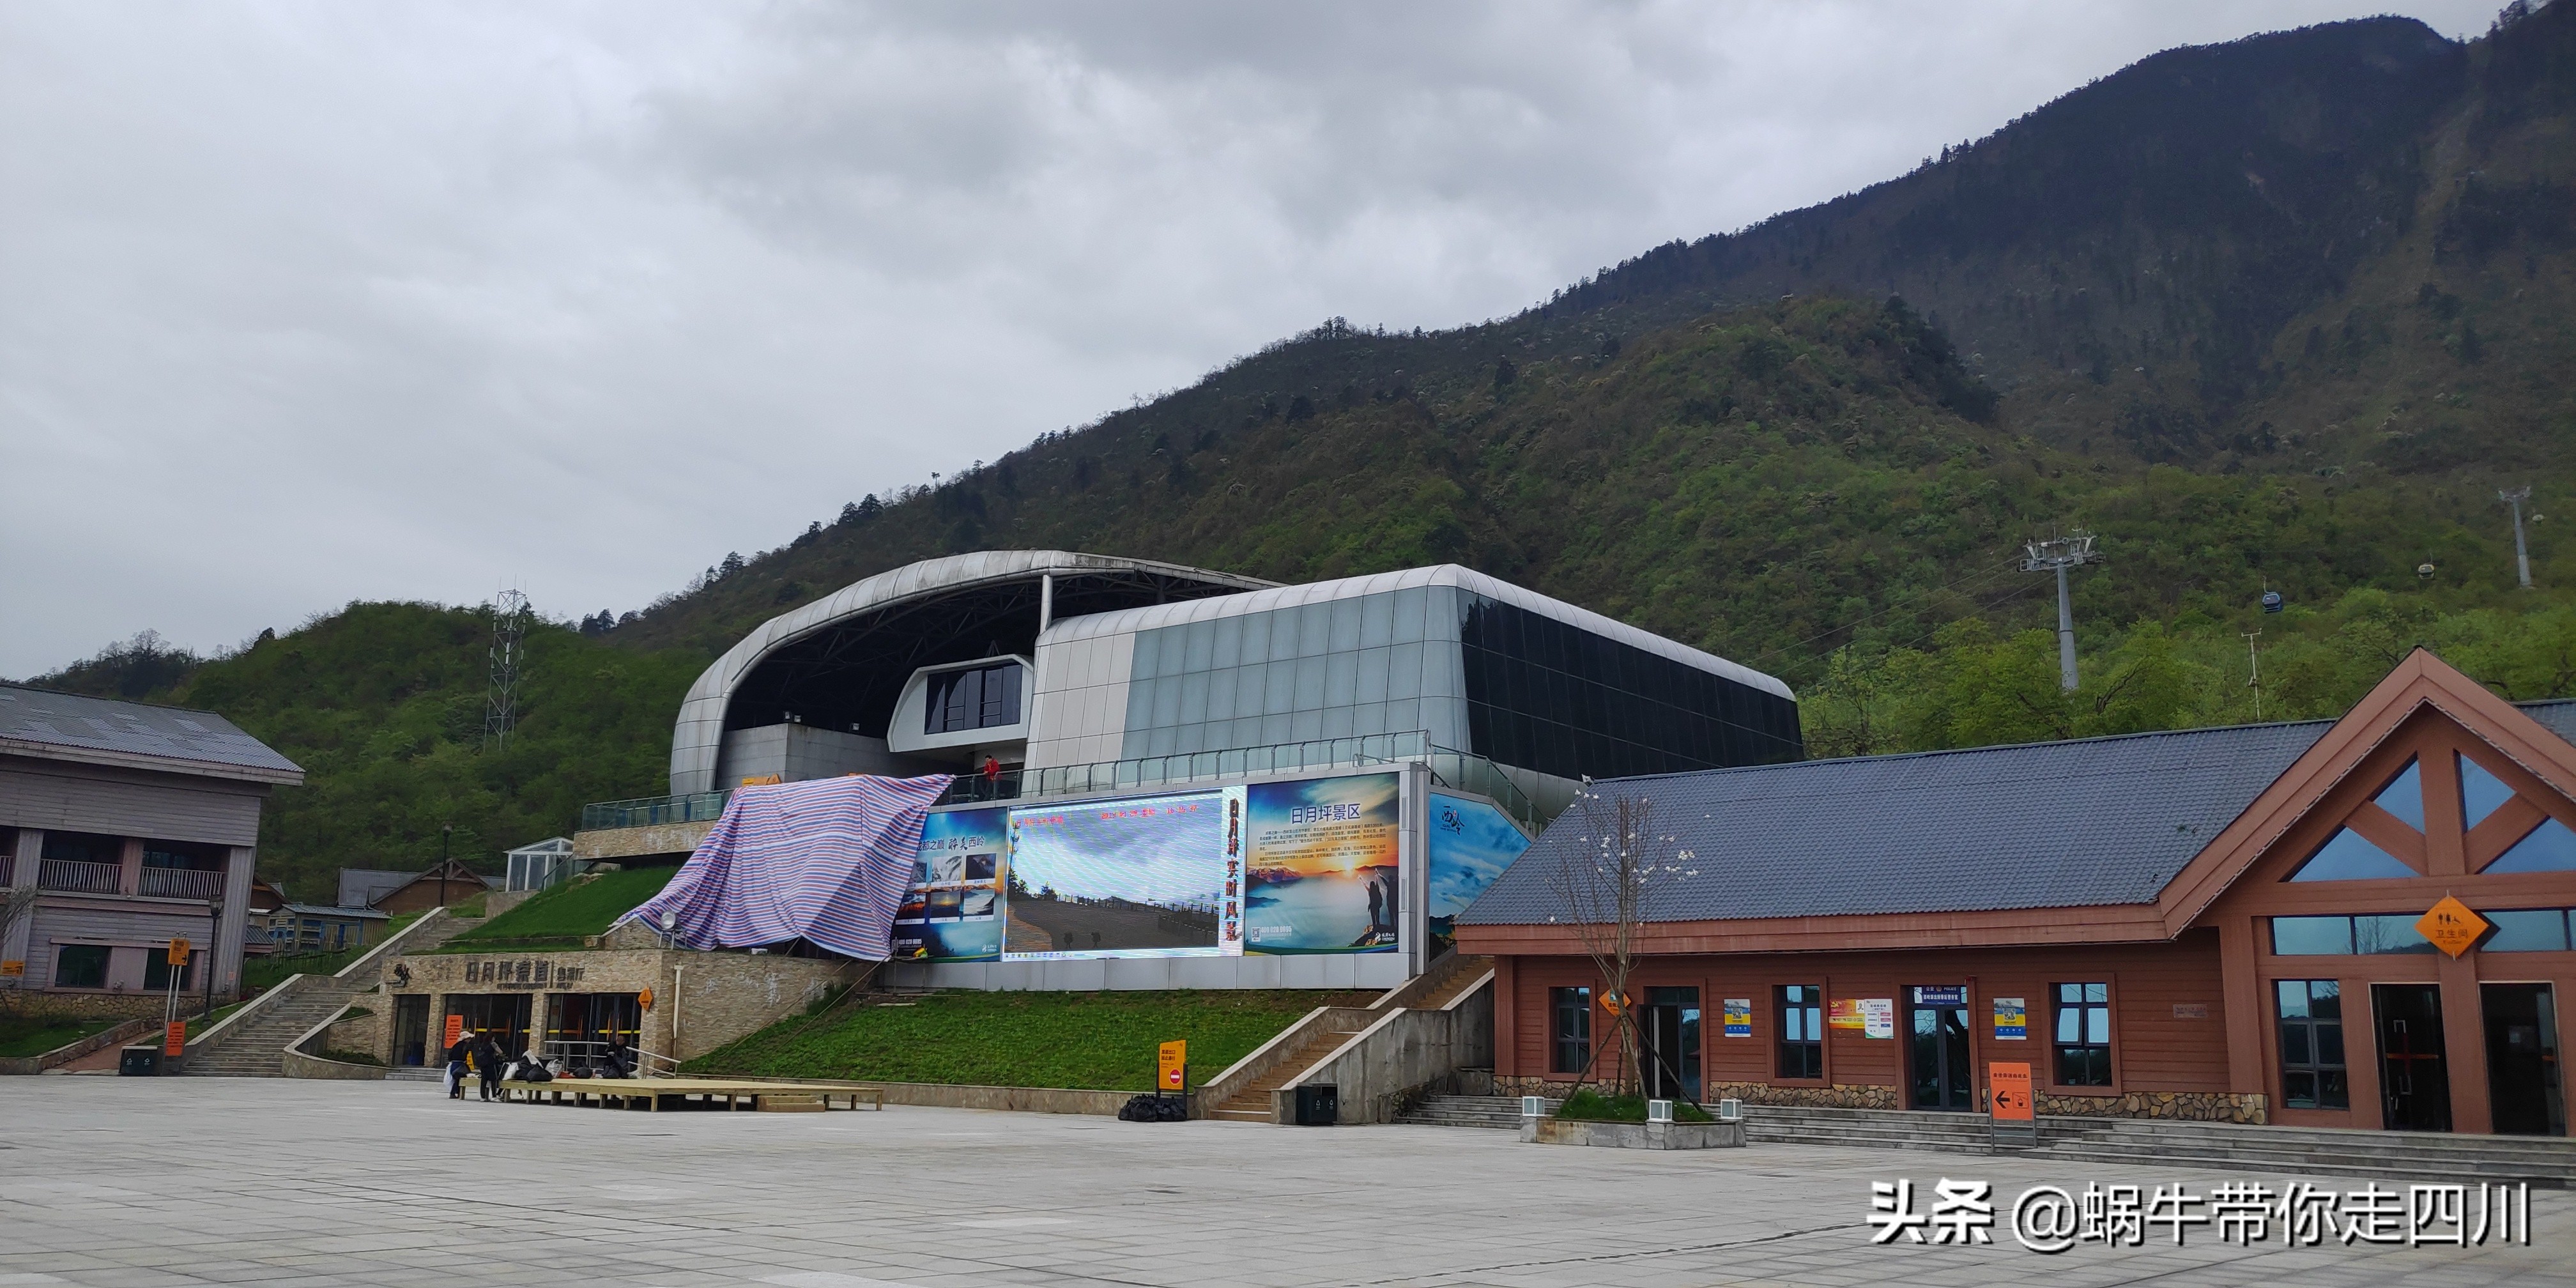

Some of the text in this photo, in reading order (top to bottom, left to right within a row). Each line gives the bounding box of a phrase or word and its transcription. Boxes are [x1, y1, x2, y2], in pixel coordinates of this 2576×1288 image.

[1292, 803, 1360, 824] 日月坪景区
[1224, 797, 1239, 941] 日月坪实时风景
[2435, 928, 2468, 939] 卫生间
[466, 960, 548, 983] 日月坪索道
